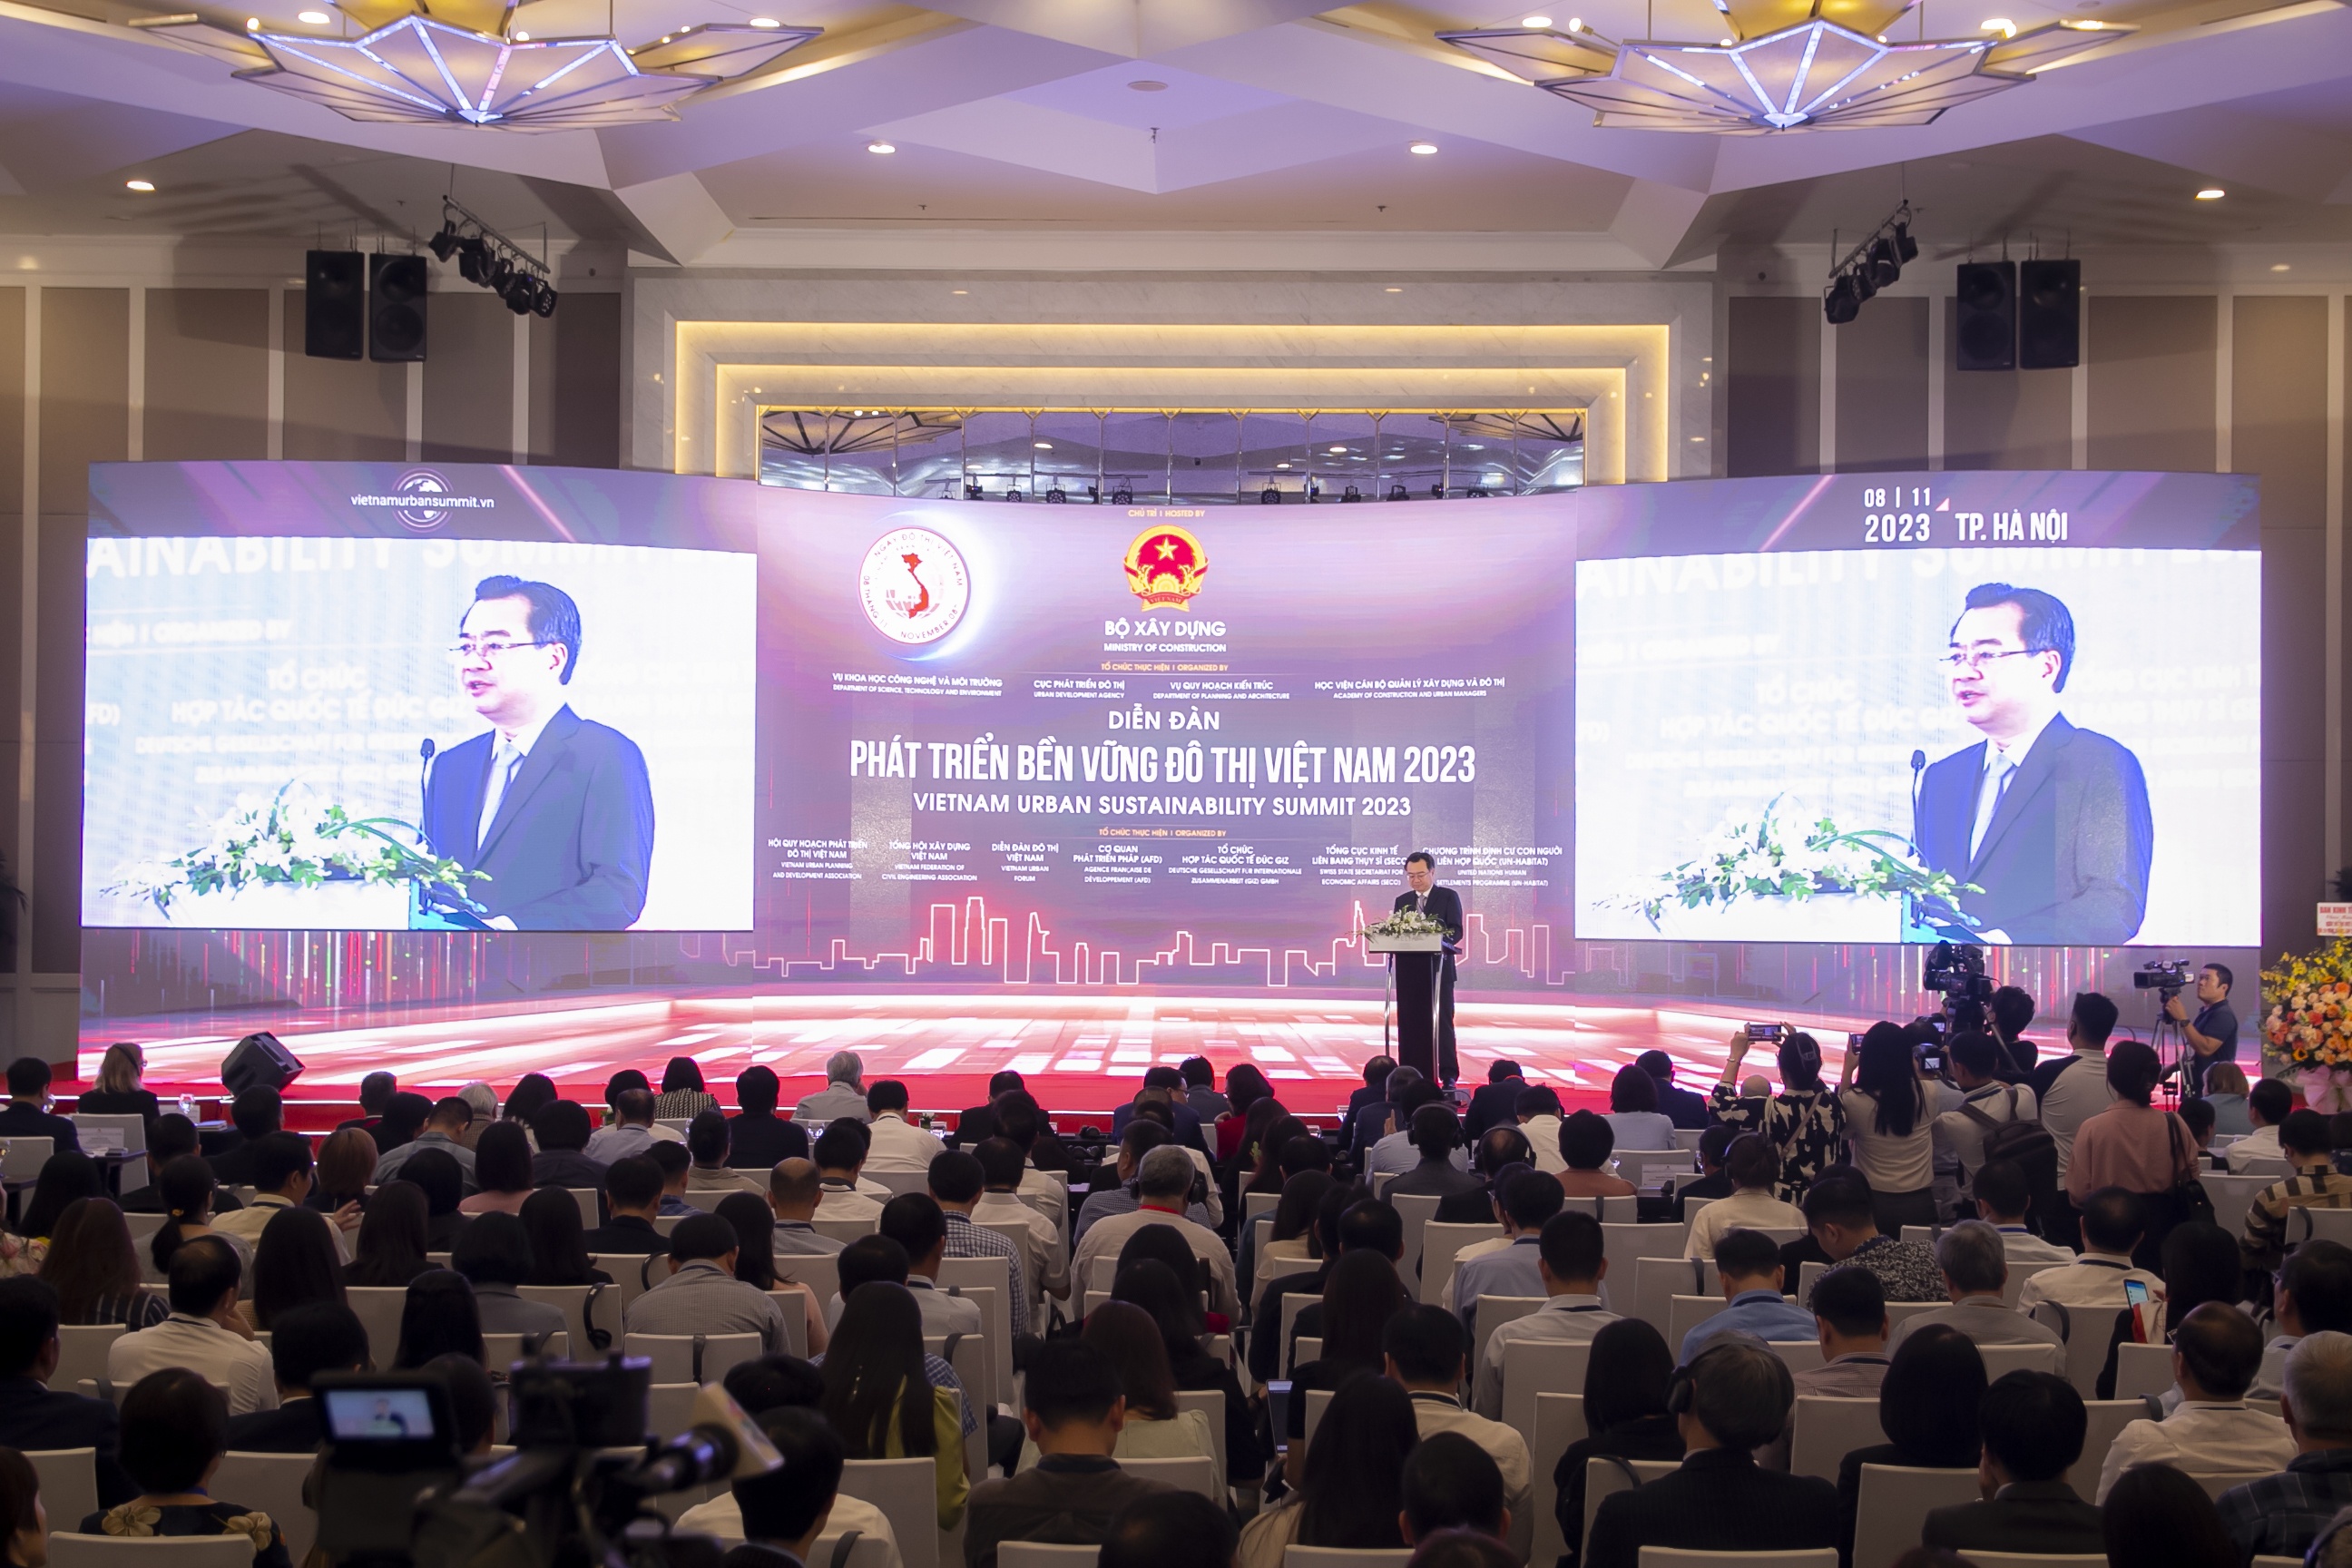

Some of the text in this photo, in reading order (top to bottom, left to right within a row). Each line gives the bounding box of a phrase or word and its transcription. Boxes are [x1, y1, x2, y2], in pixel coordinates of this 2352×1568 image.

[350, 494, 495, 508] vietnamurbansummit.vn
[1864, 488, 1886, 507] 08
[1912, 487, 1930, 506] 11
[1865, 513, 1930, 543] 2023
[1955, 508, 2068, 544] TP. HÀ NỘI
[900, 620, 949, 640] NOVEMBER
[1104, 617, 1227, 640] BỘ XÂY DỰNG
[1103, 643, 1227, 652] MINISTRY OF CONSTRUCTION
[1108, 703, 1220, 730] DIỄN ĐÀN
[850, 731, 1475, 789] PHÁT TRIỂN BỀN VỮNG ĐÔ THỊ VIỆT NAM 2023
[913, 792, 1412, 817] VIETNAM URBAN SUSTAINABILITY SUMMIT 2023
[1276, 856, 1289, 865] GIZ
[1516, 847, 1535, 855] CON
